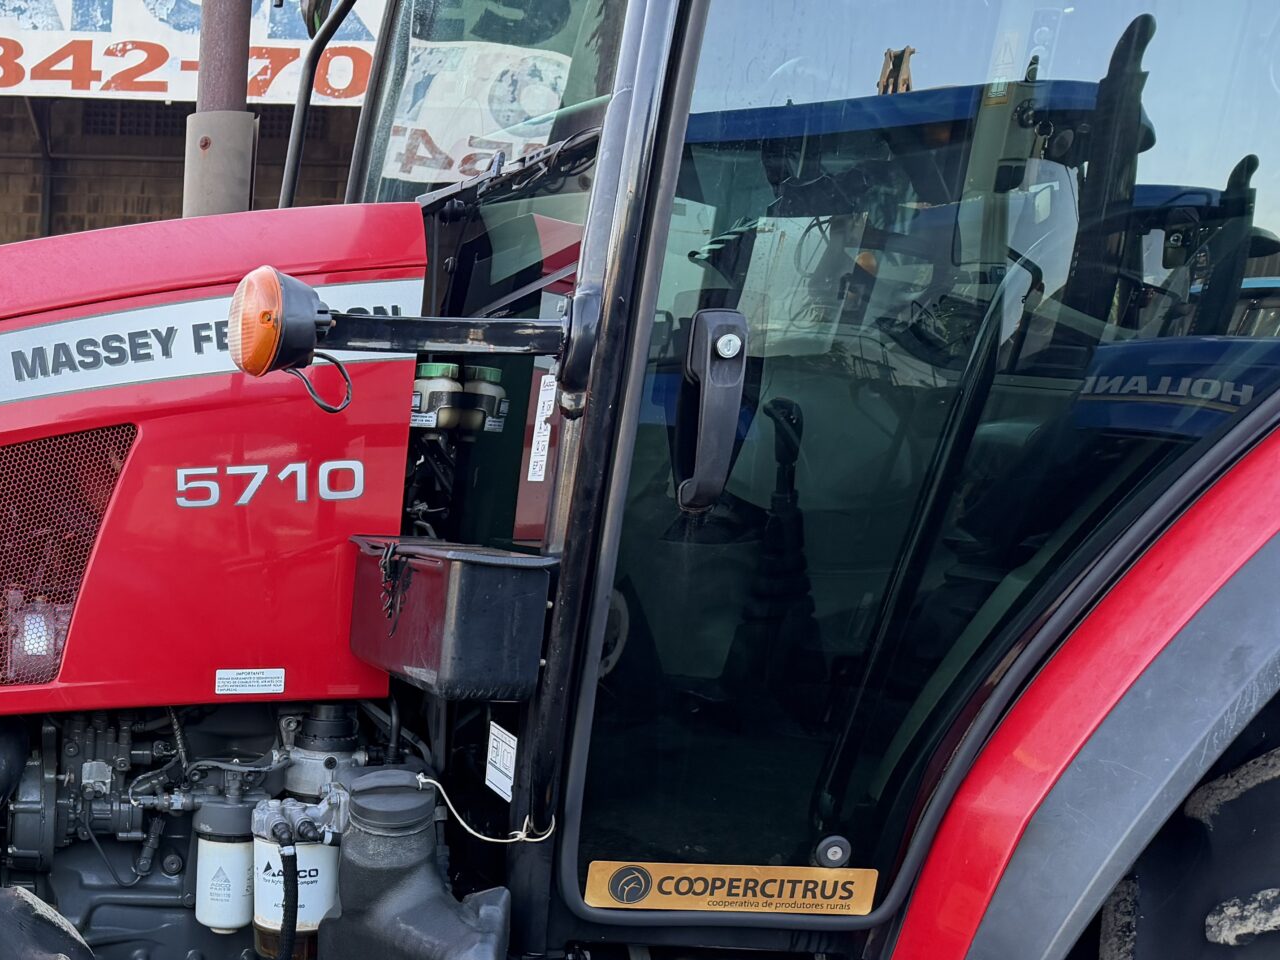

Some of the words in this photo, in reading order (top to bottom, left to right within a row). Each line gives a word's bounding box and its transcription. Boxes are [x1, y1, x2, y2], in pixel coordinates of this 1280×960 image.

[11, 326, 178, 382] MASSEY
[175, 460, 364, 507] 5710
[277, 868, 319, 879] ACO
[657, 875, 855, 901] COOPERCITRUS
[707, 900, 759, 910] cooperativa
[761, 901, 773, 910] de
[775, 901, 824, 911] produtores
[826, 903, 851, 911] rurais
